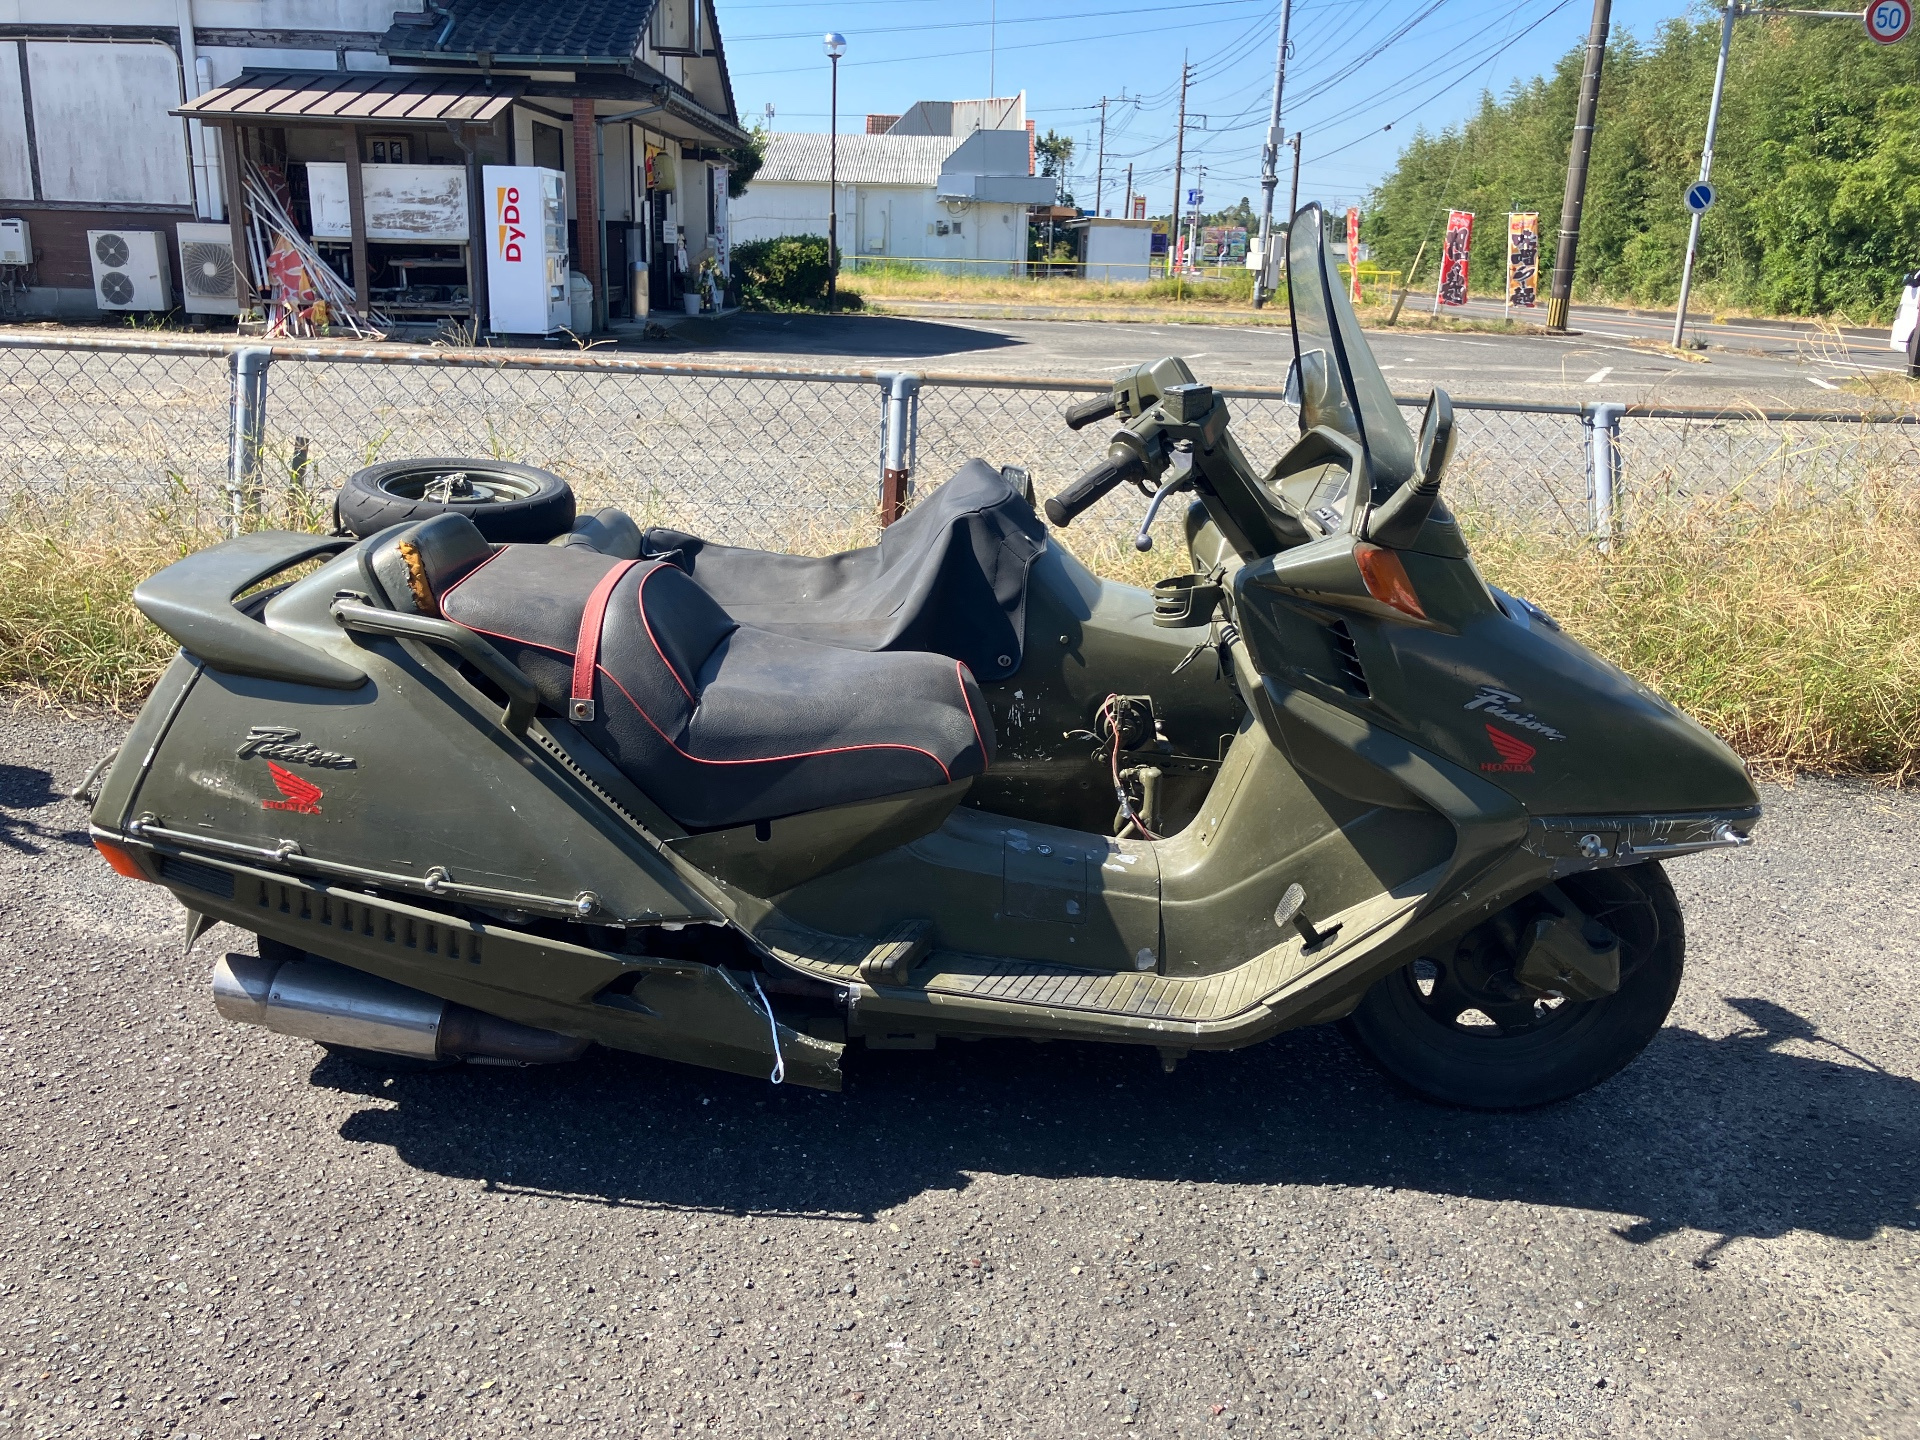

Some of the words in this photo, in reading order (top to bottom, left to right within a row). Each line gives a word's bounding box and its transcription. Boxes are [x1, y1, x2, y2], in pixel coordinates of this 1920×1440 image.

[1875, 7, 1902, 29] 50
[504, 187, 526, 262] DyDo
[1480, 762, 1535, 774] HONDA
[261, 799, 322, 815] HONDA
